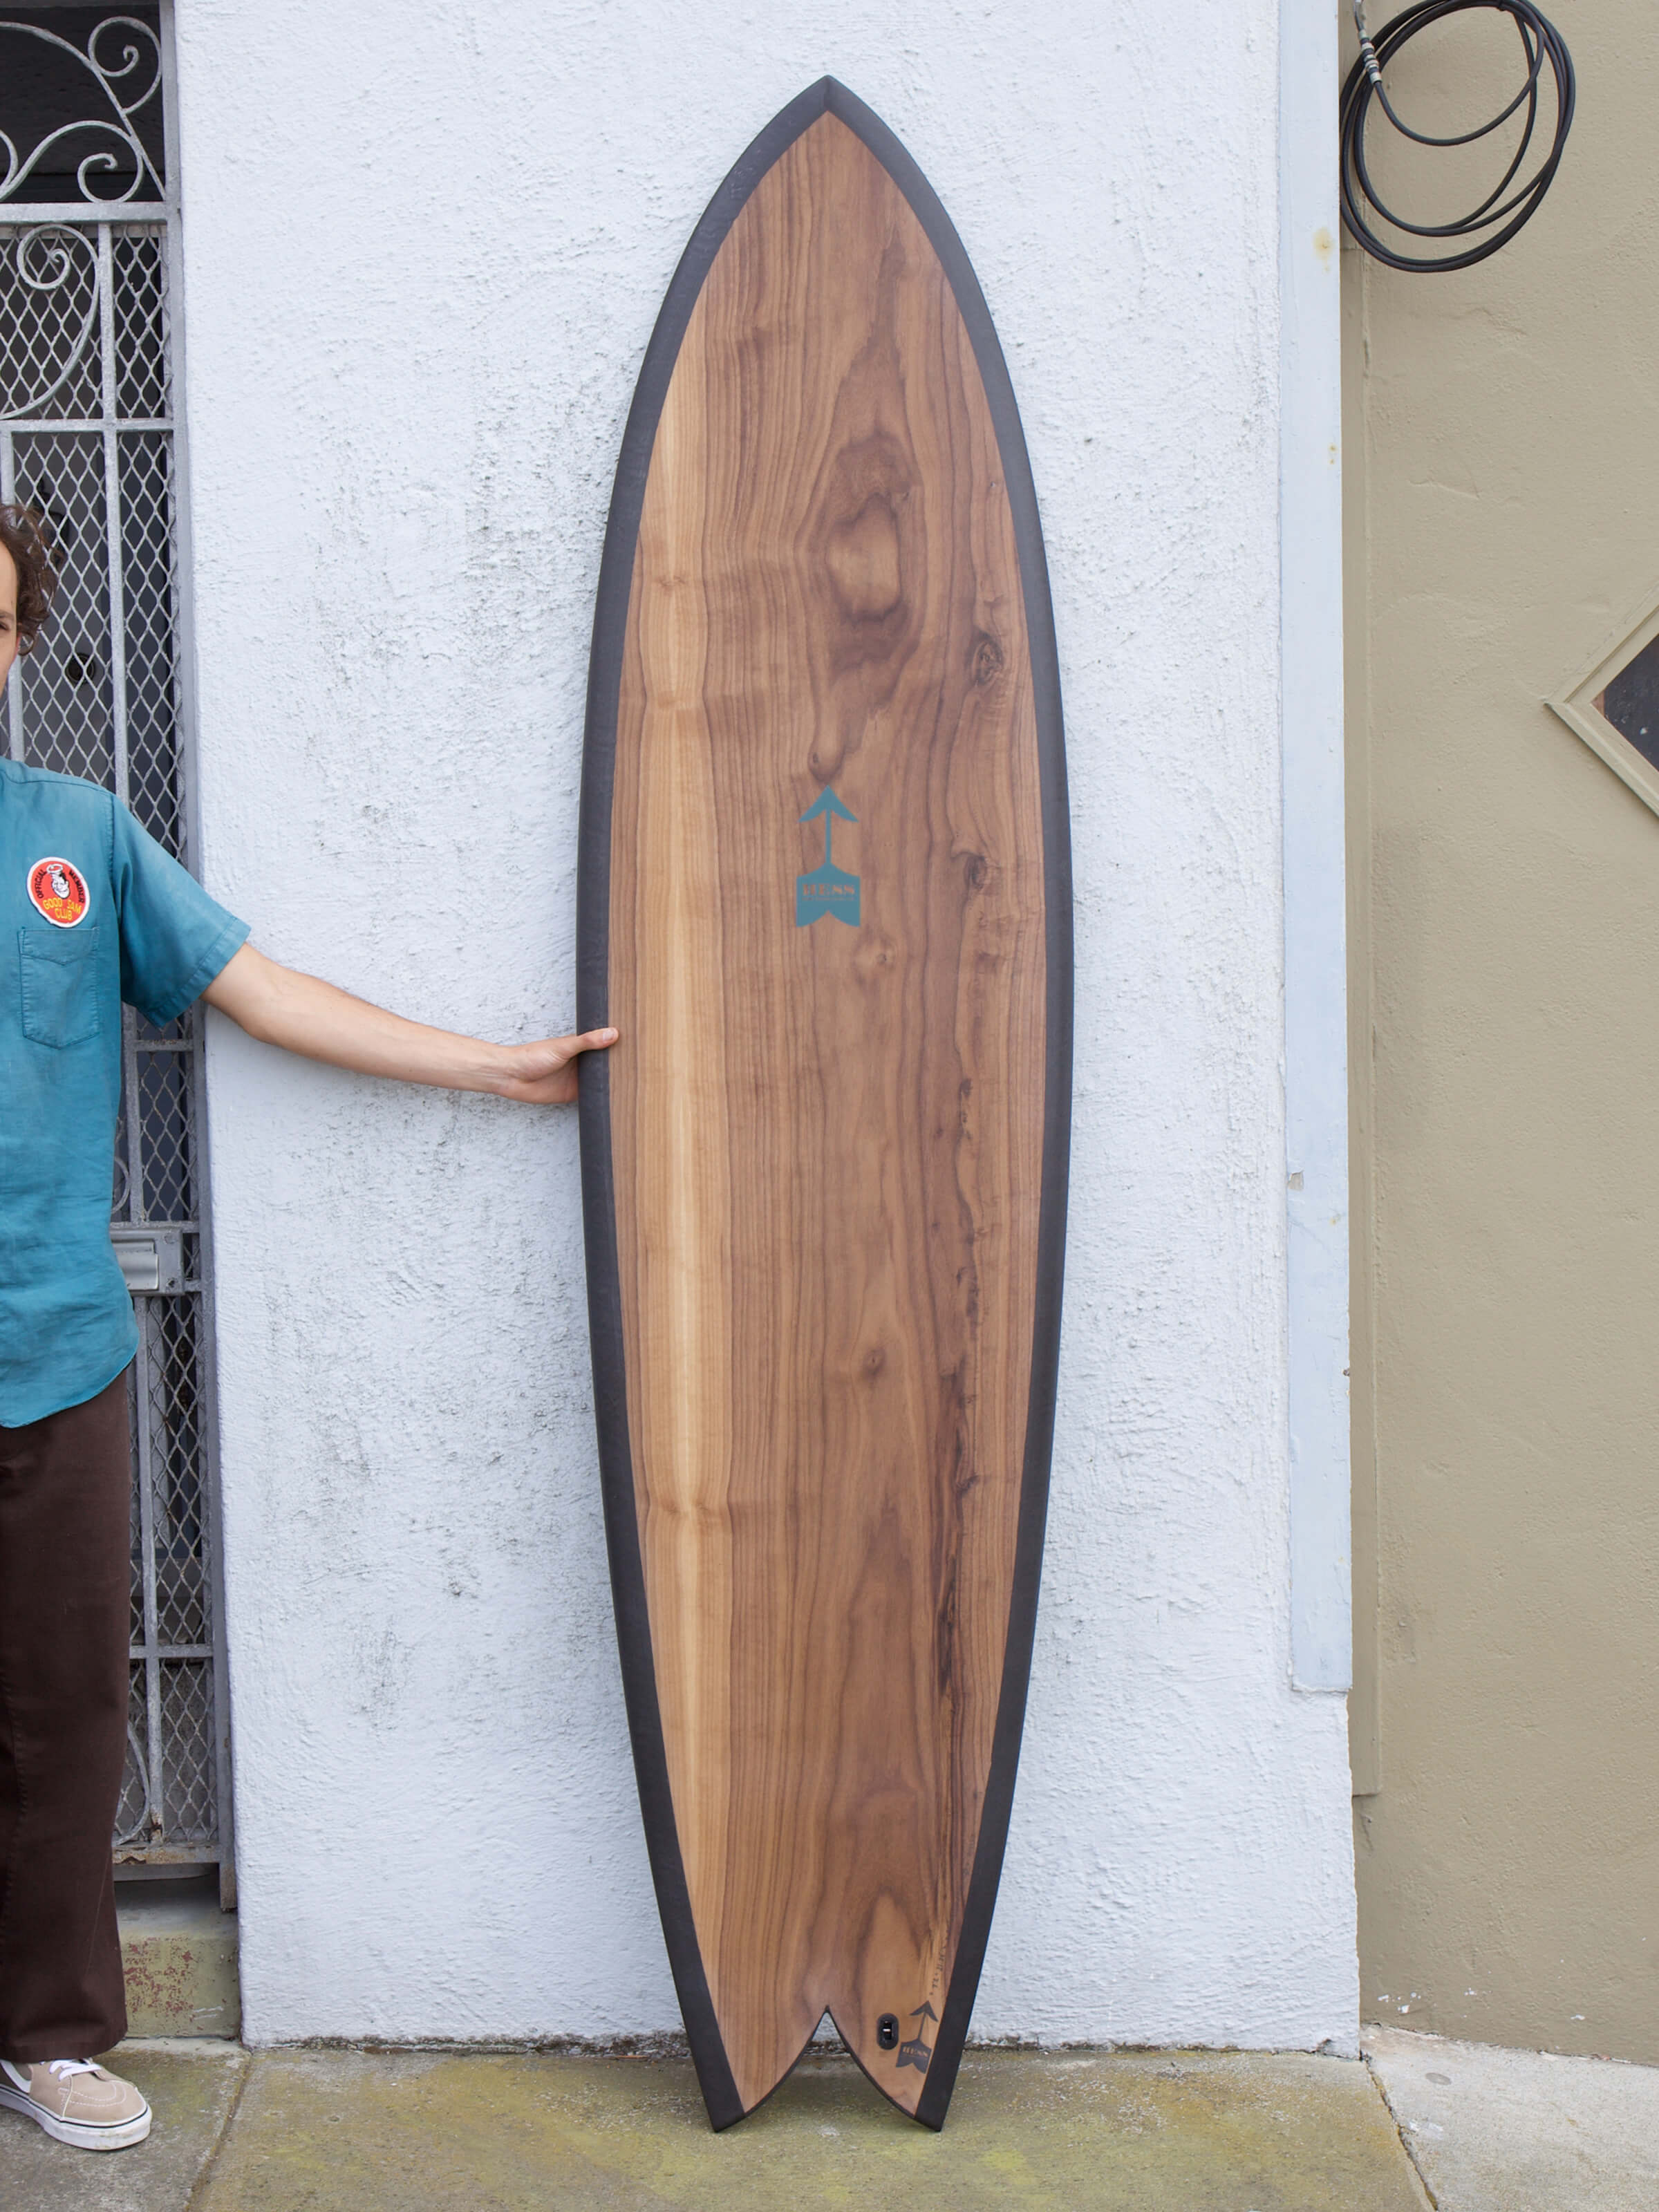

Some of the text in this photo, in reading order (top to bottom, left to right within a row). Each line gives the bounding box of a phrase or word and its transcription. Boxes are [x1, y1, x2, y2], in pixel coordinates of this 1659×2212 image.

[34, 869, 85, 903] OFFICIAL MEMBER
[802, 884, 855, 896] HESS
[43, 898, 82, 914] GOOD SAM
[55, 908, 73, 920] CLUB
